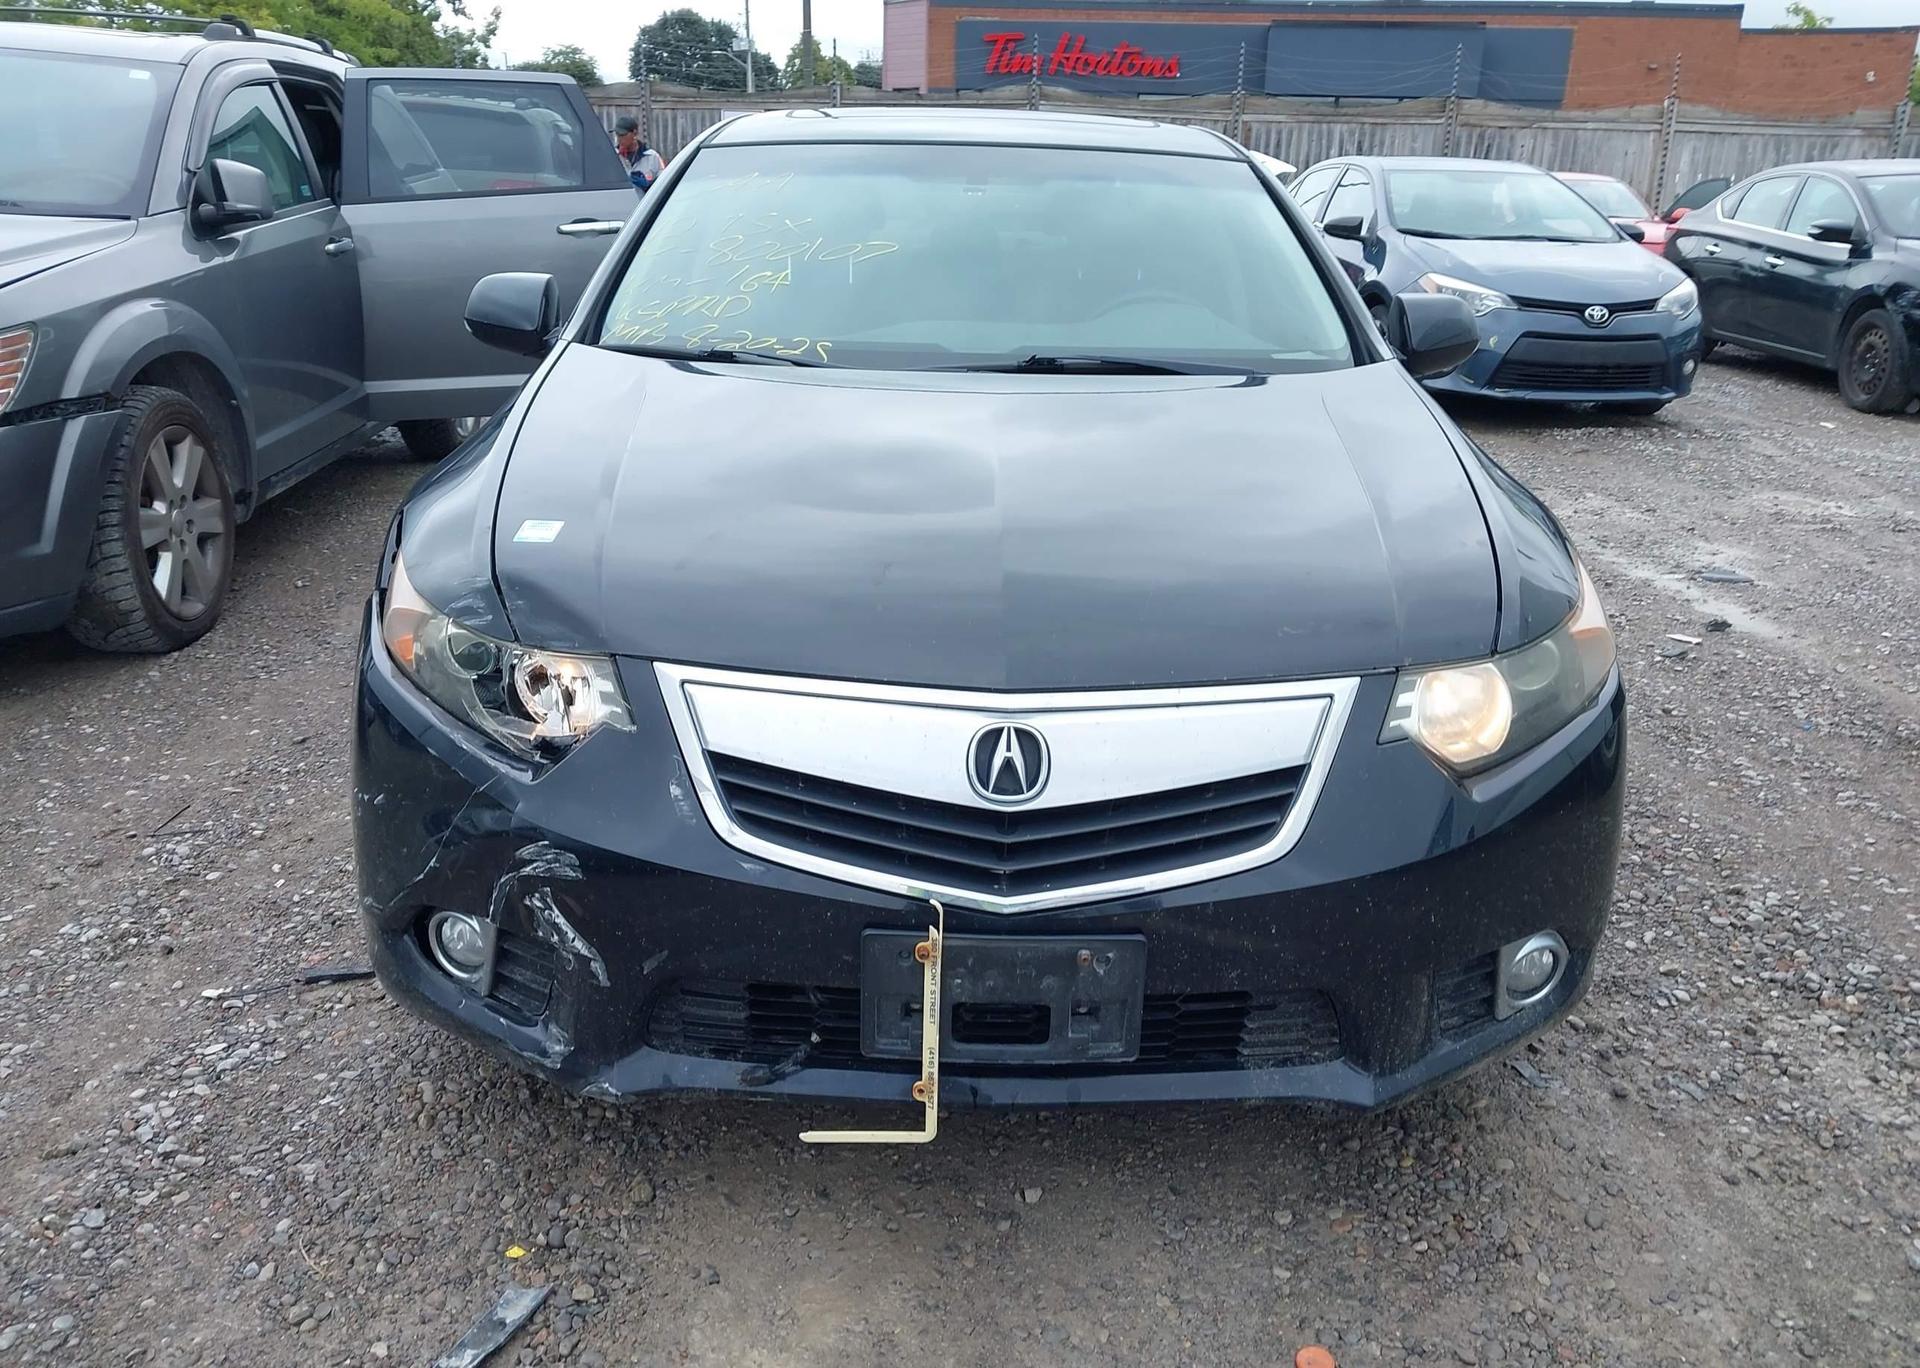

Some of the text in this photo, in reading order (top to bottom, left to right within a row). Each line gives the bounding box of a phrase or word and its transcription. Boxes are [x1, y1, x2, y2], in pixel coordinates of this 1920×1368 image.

[983, 31, 1181, 79] Tim Hortons
[930, 955, 938, 987] FRONT
[929, 989, 937, 1026] STREET
